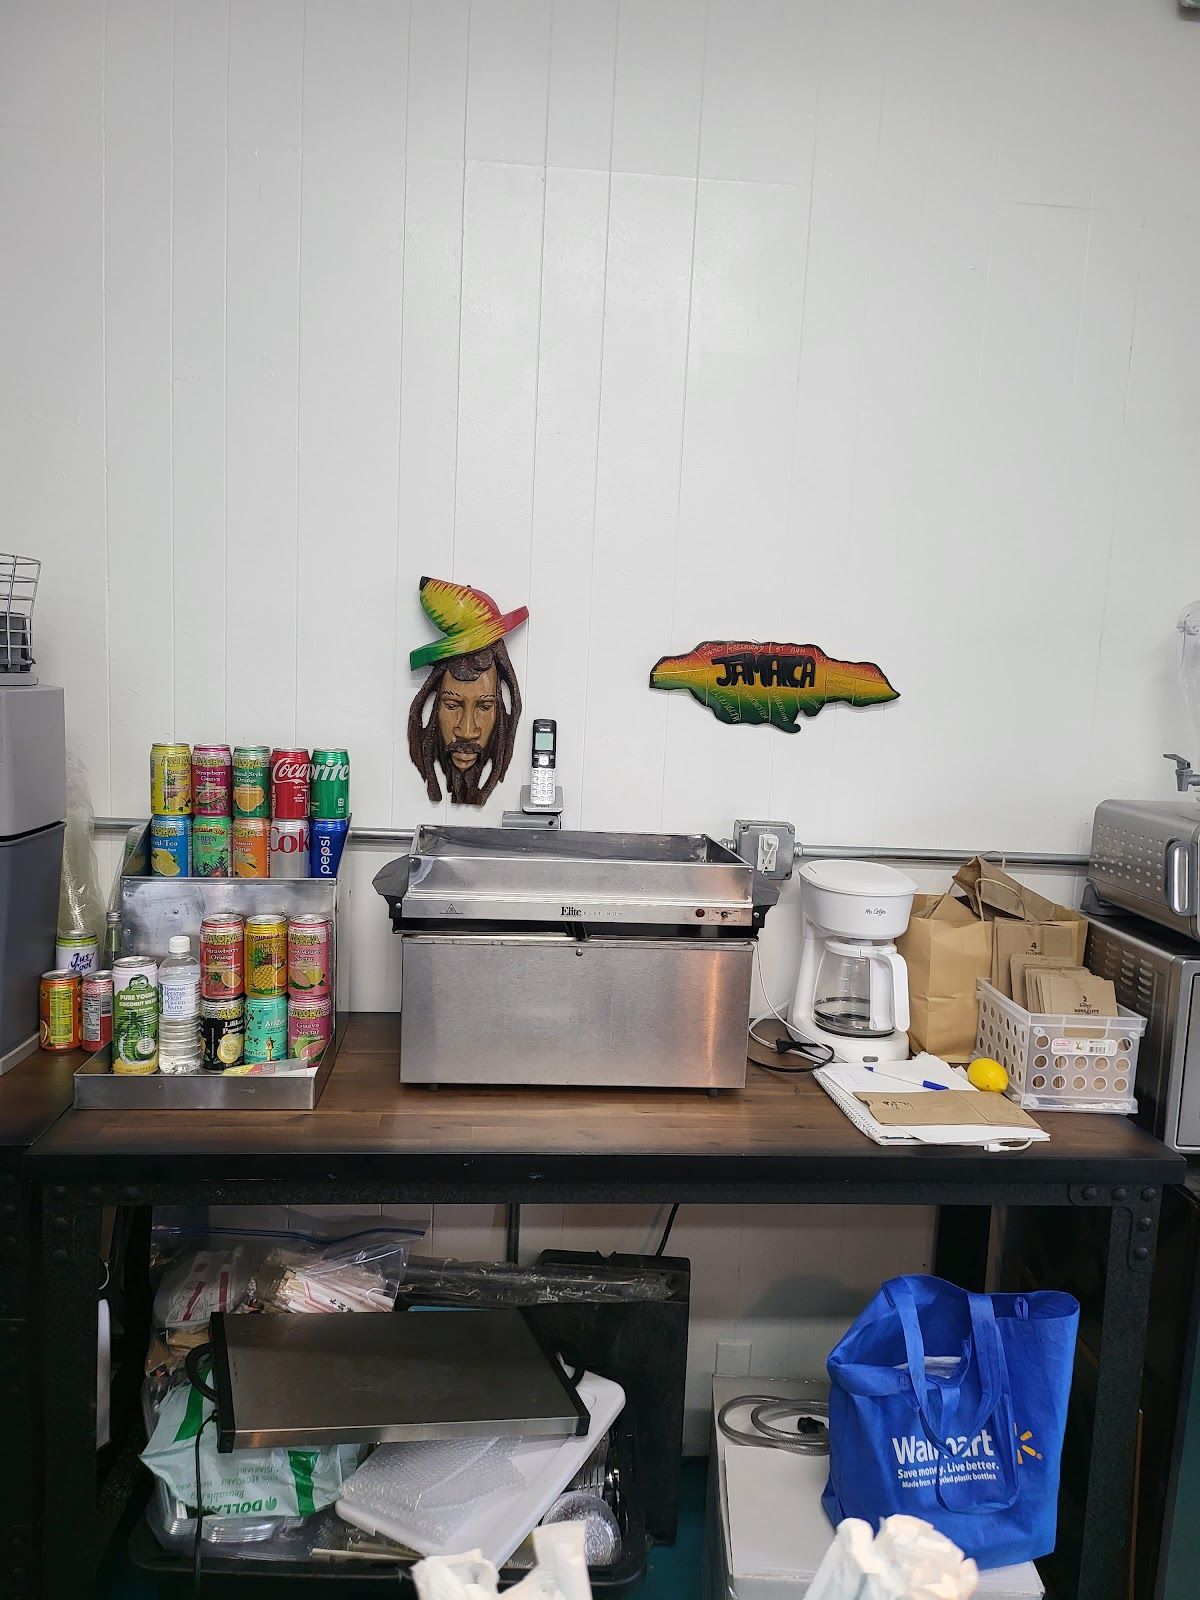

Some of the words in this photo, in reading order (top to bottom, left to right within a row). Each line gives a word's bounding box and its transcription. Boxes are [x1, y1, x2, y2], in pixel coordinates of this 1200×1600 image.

[711, 653, 816, 689] JAMAICA
[163, 839, 178, 847] Tea
[319, 835, 333, 875] pepsi
[561, 906, 582, 917] Elite
[205, 946, 239, 954] Strawberry
[296, 1028, 320, 1036] Nectar
[897, 1468, 918, 1479] Save
[946, 1461, 965, 1473] Live
[966, 1460, 1000, 1471] better.
[902, 1479, 919, 1488] Made
[931, 1474, 954, 1486] rycled
[954, 1473, 972, 1483] plastic
[972, 1471, 997, 1481] bottles
